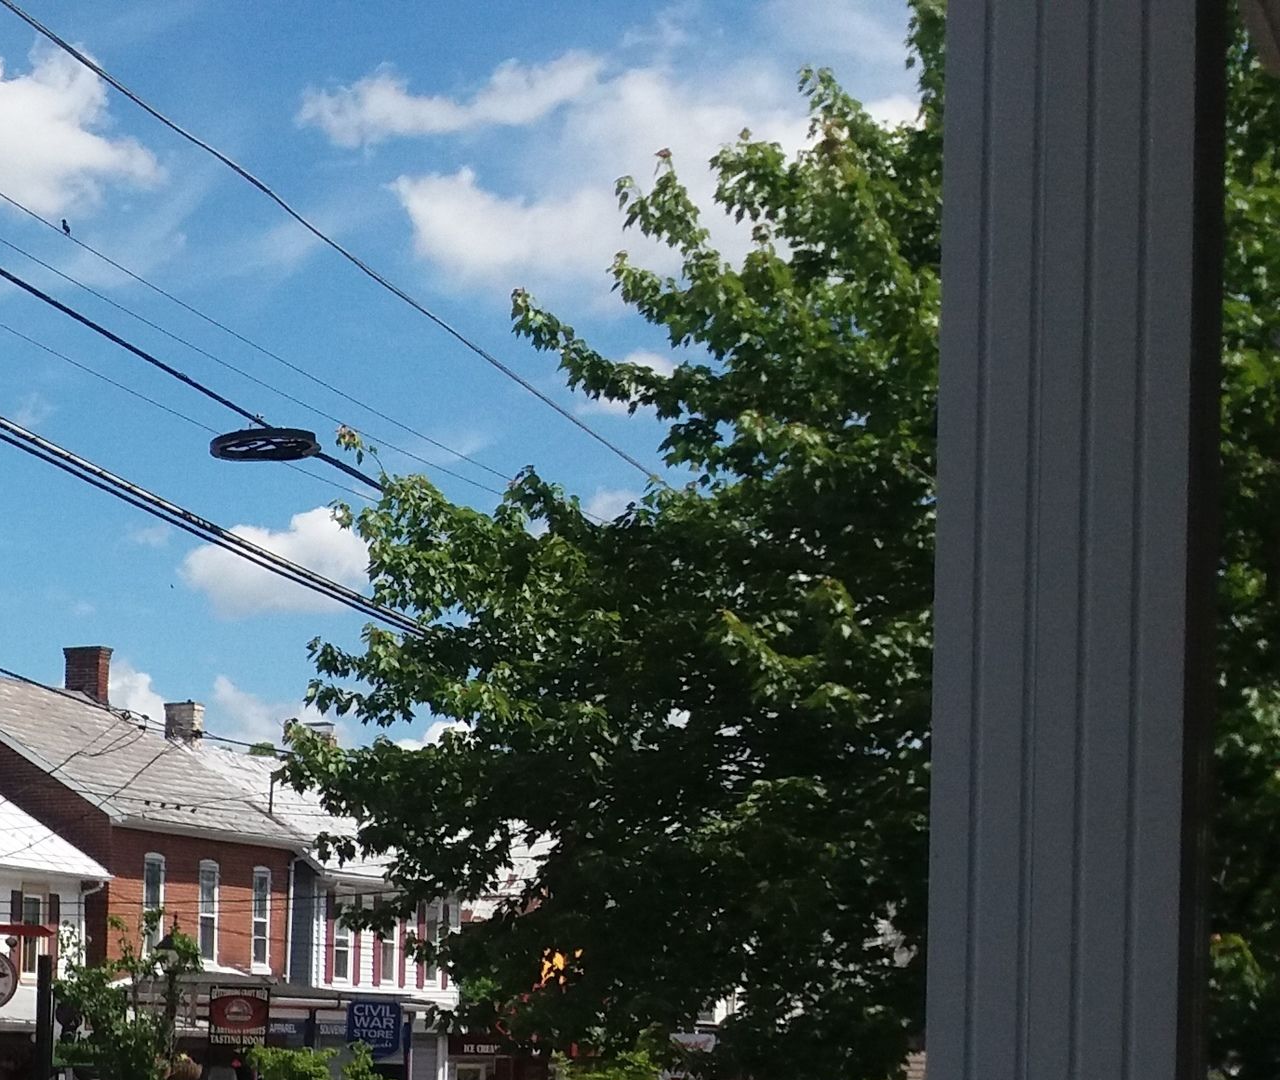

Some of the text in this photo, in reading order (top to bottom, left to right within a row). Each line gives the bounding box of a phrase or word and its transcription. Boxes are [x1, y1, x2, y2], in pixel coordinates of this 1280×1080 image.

[353, 1003, 396, 1018] CIVIL
[353, 1016, 395, 1029] WAR
[269, 1023, 297, 1034] APPAREL
[352, 1029, 394, 1039] STORE
[210, 1034, 265, 1046] TASTING ROOM
[463, 1044, 497, 1054] ICE CREA
